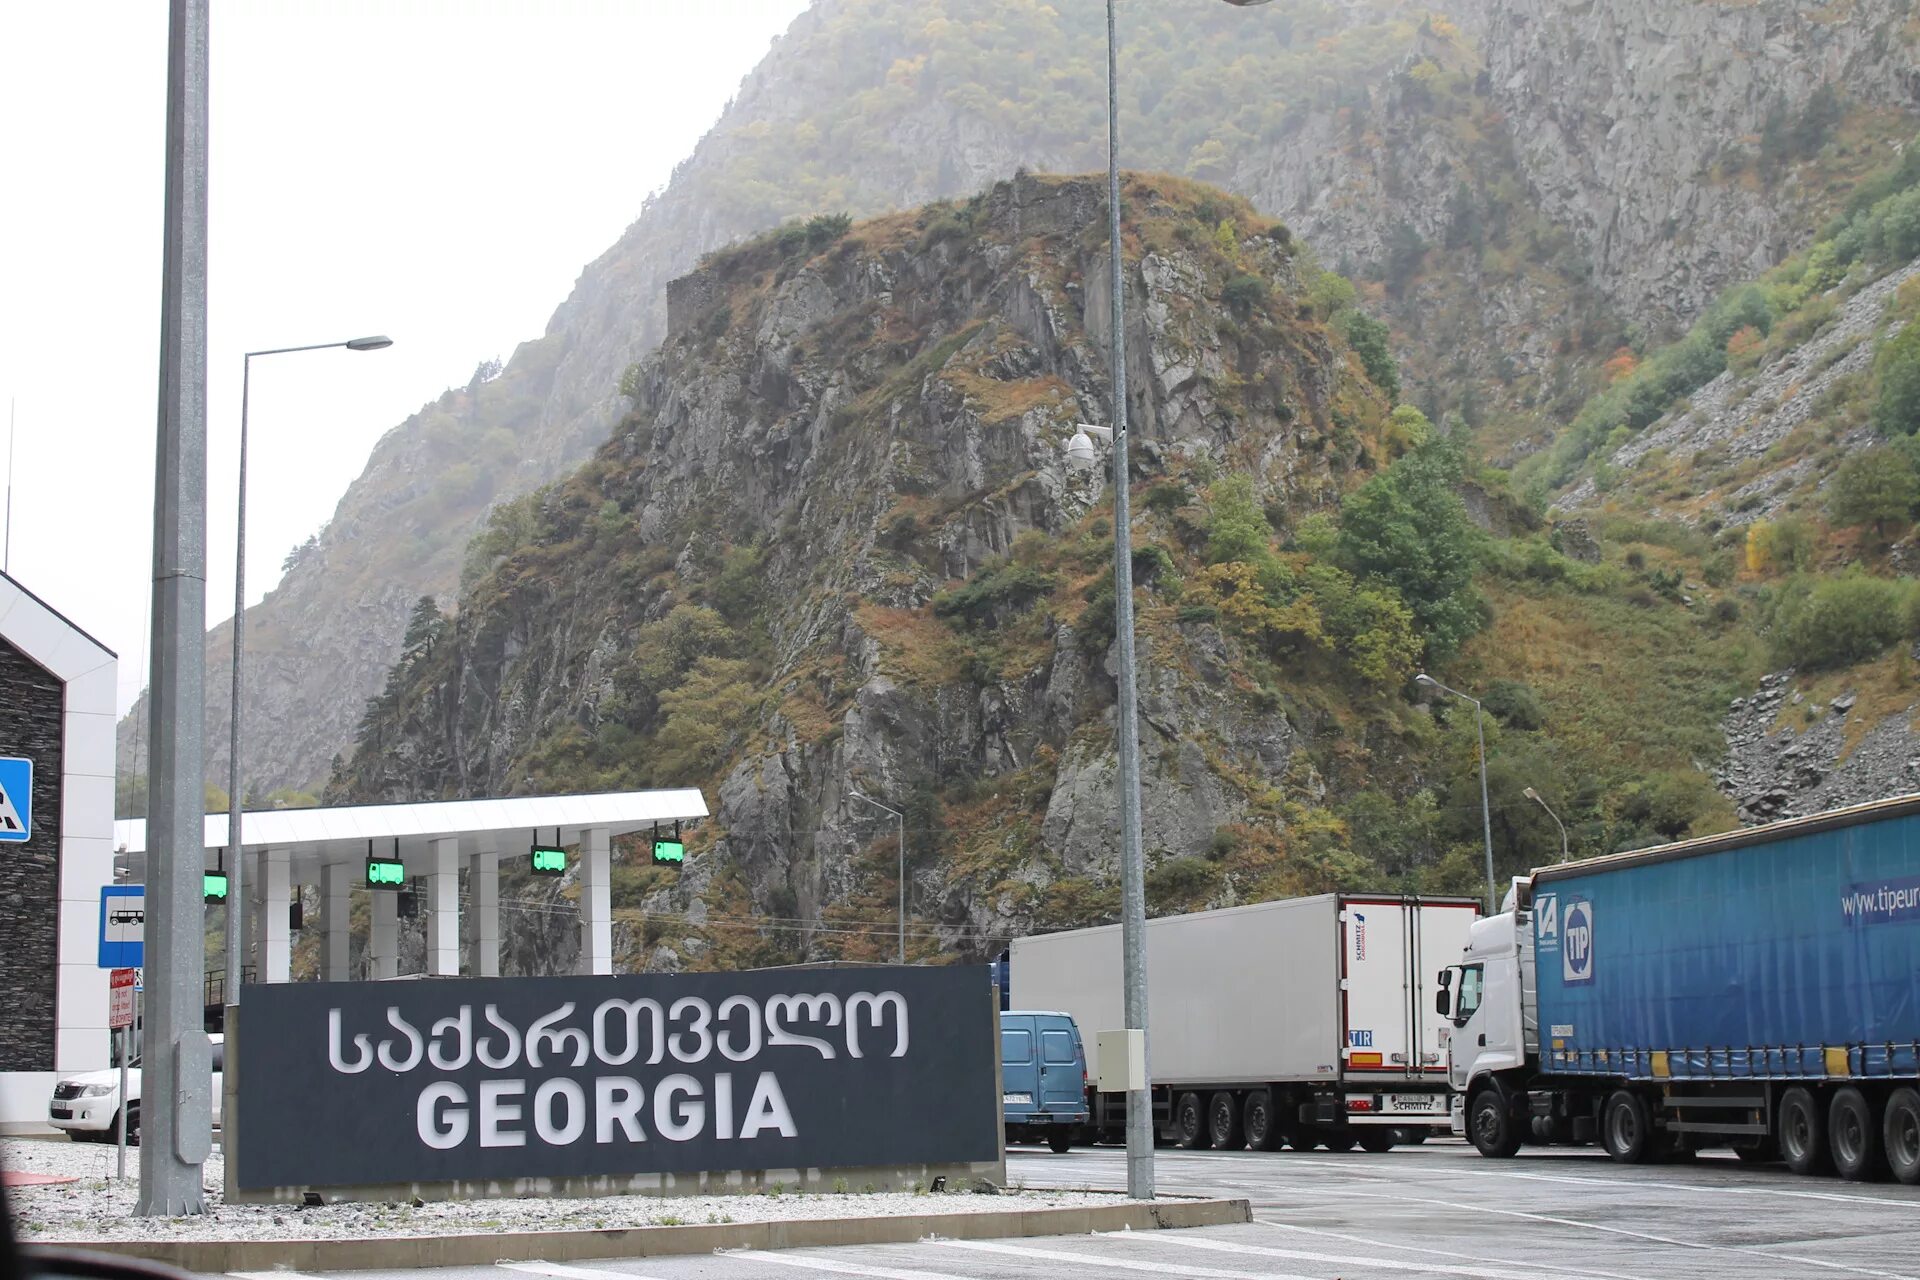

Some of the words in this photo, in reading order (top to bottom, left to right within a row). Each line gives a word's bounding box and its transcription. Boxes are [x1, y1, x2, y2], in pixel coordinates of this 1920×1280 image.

[1567, 926, 1588, 960] TIP
[328, 990, 910, 1074] საქართველო
[1350, 1031, 1371, 1046] TIR
[416, 1071, 799, 1150] GEORGIA
[1393, 1102, 1433, 1111] SCHMITZ
